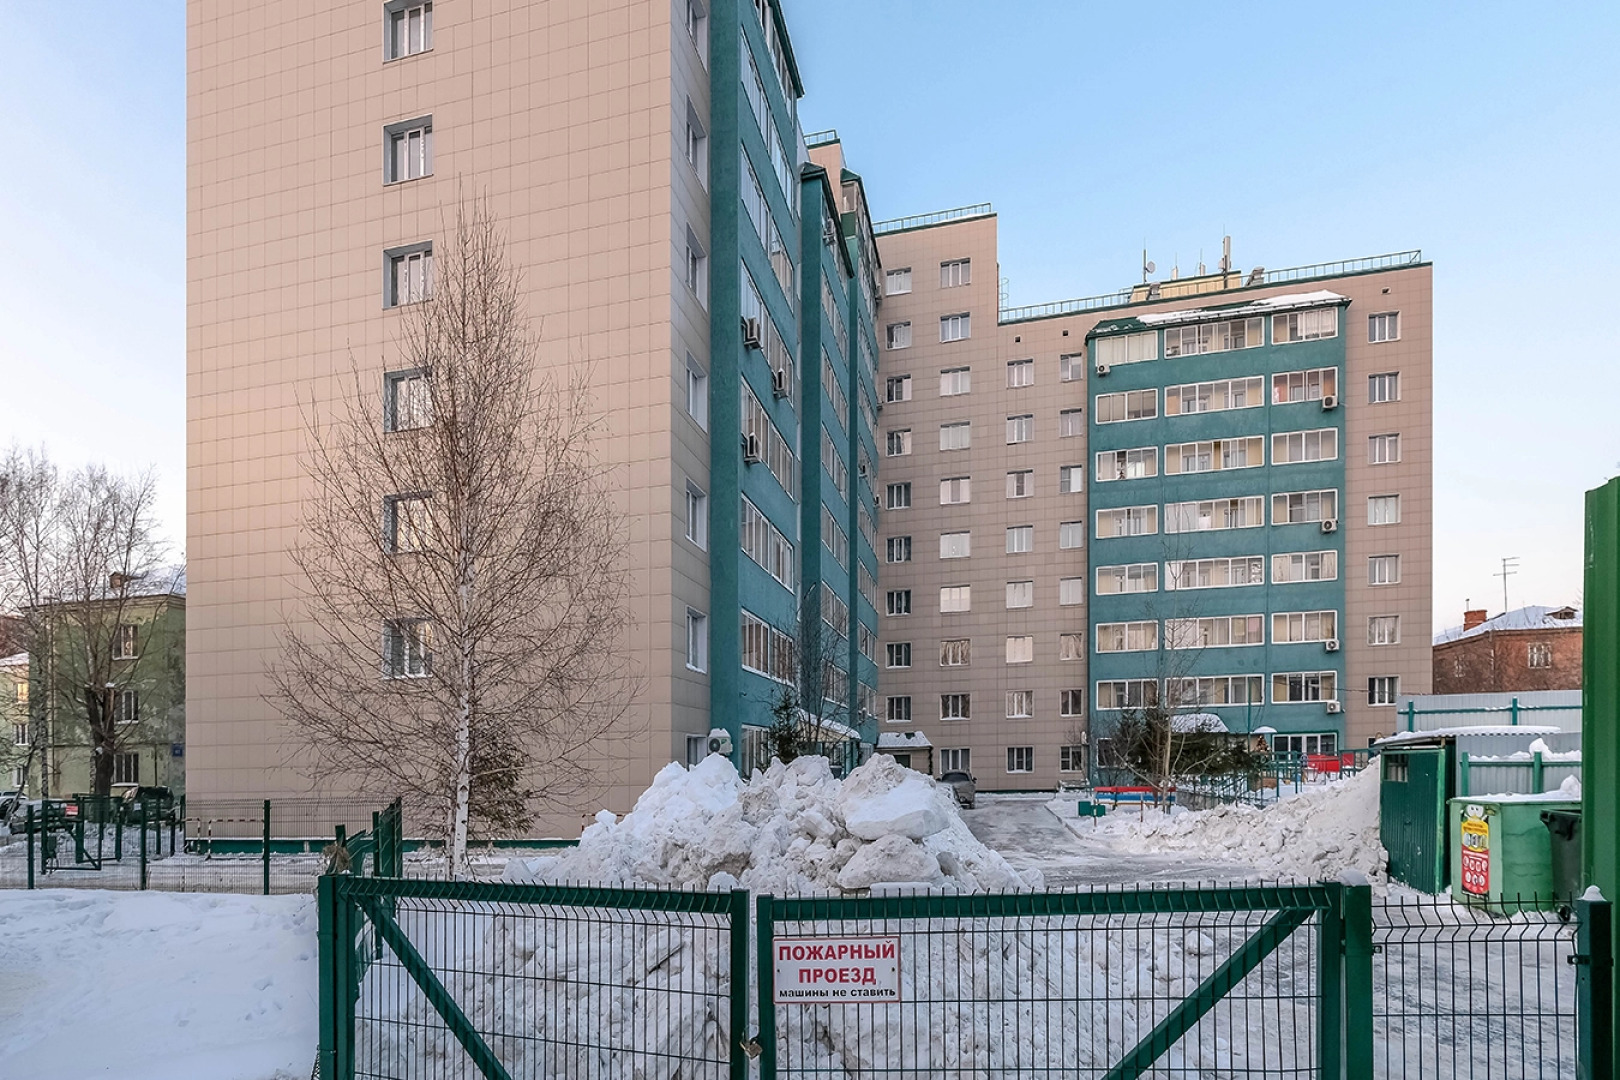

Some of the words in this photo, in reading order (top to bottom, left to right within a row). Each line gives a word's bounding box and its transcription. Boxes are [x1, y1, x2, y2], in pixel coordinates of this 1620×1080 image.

[779, 940, 895, 961] ПОЖАРНЫЙ
[799, 967, 877, 986] ПРОЕЗД
[779, 989, 829, 998] машины
[832, 989, 847, 997] не
[850, 988, 896, 997] ставить
